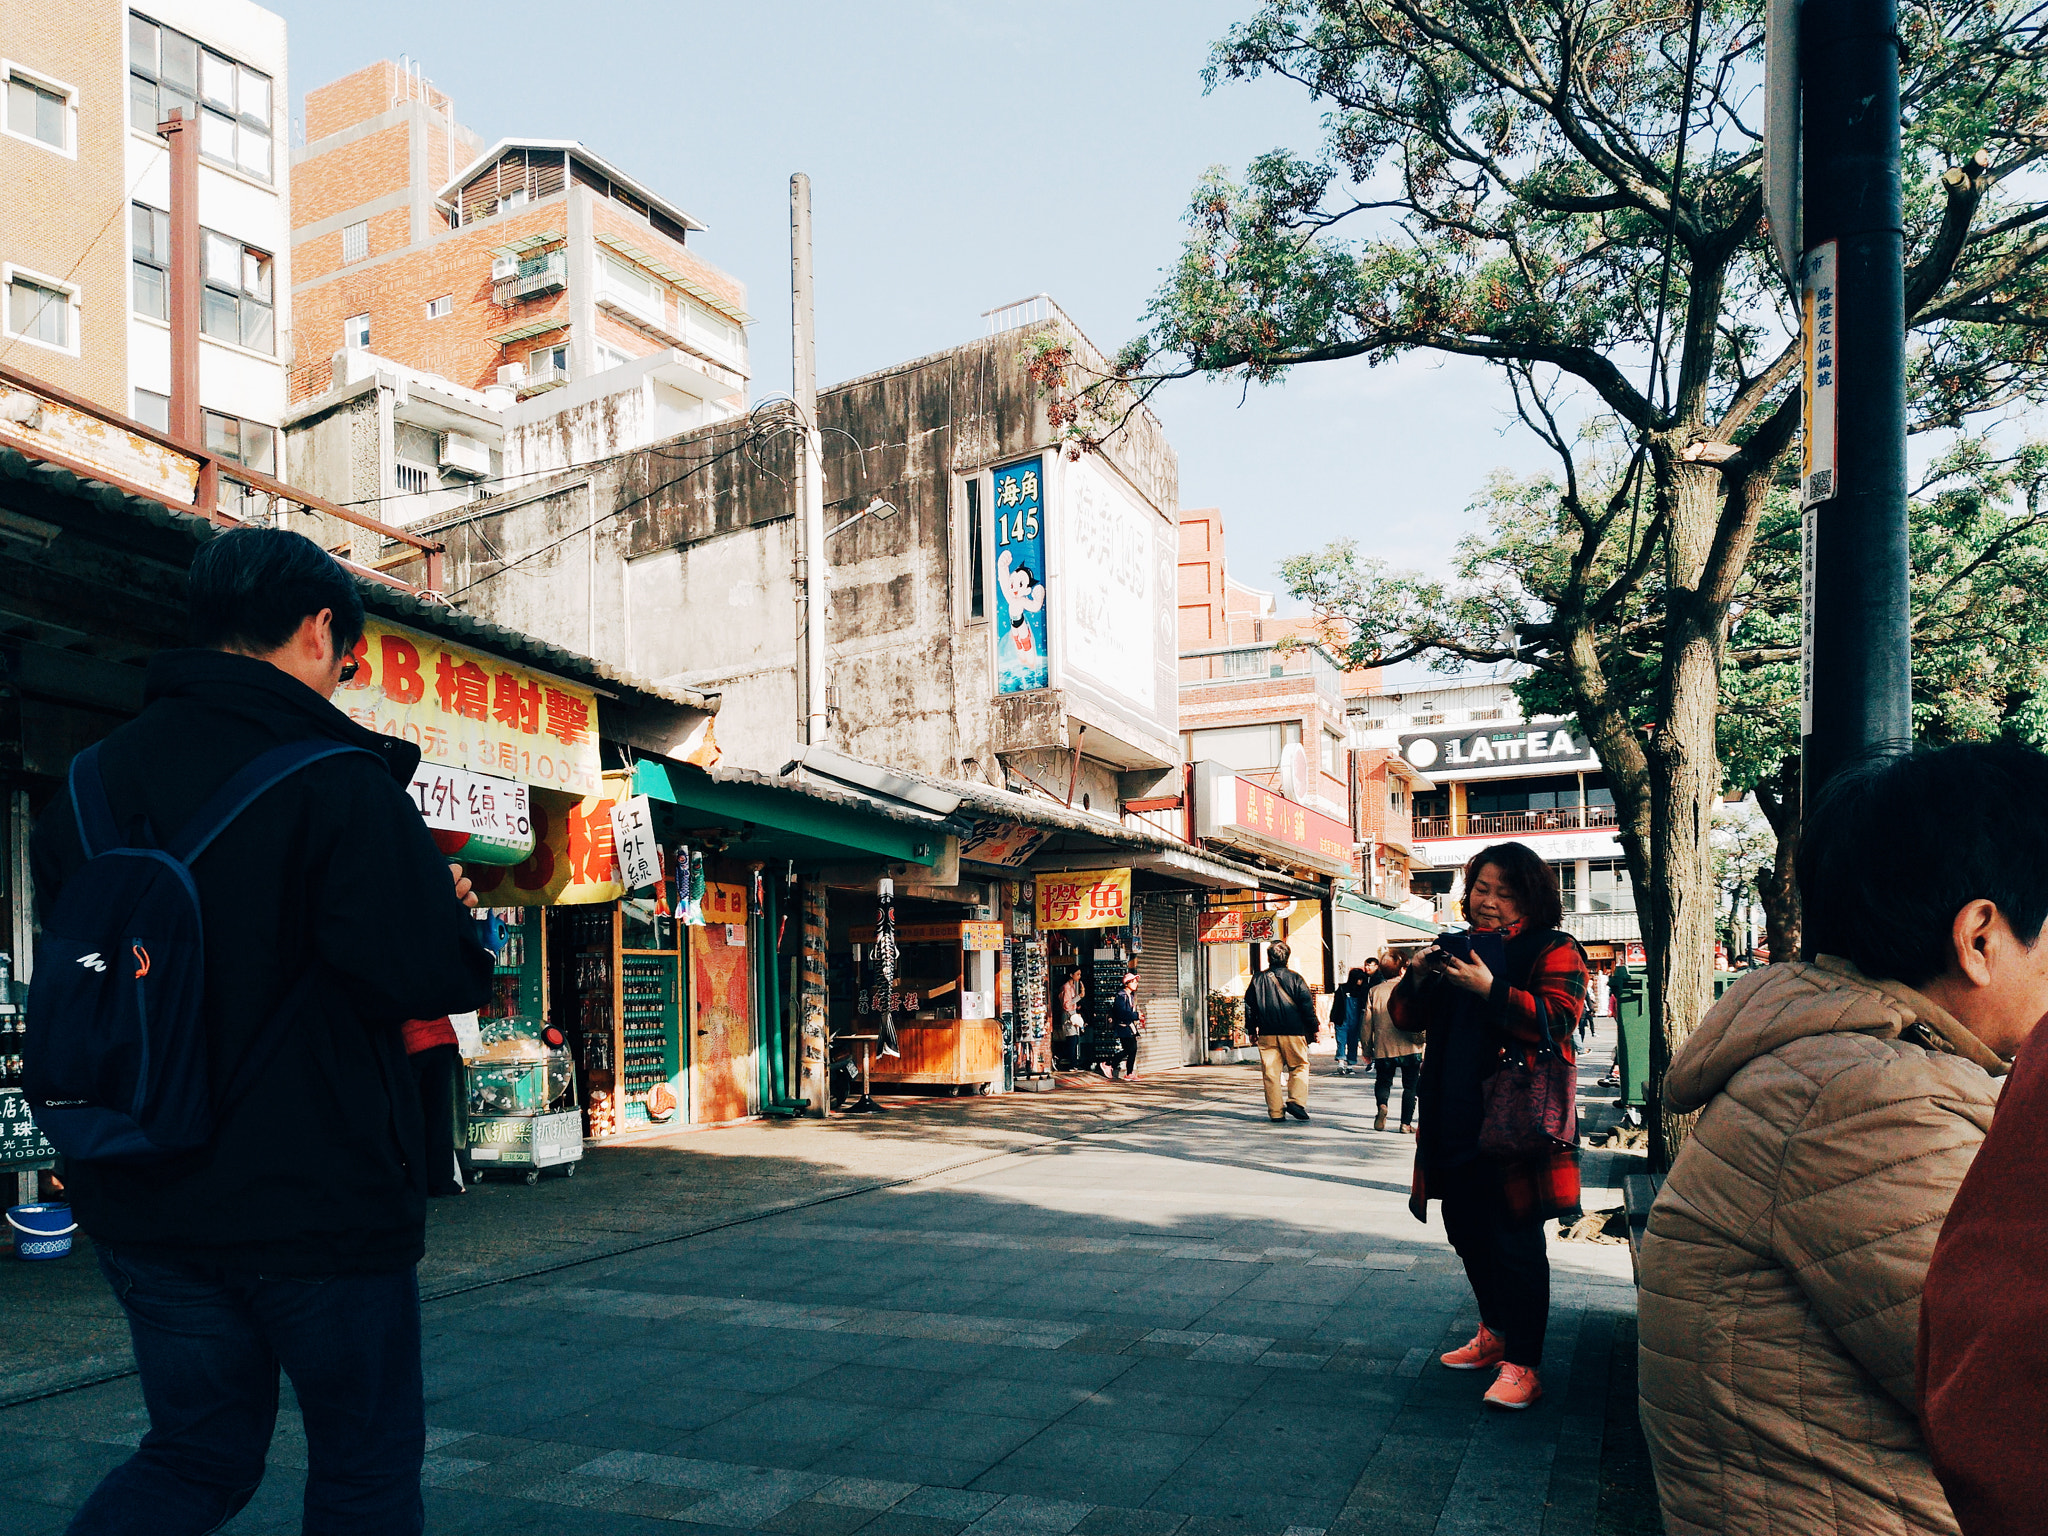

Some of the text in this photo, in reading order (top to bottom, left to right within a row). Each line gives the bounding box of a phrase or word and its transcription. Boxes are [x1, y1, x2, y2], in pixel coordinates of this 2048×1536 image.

[1817, 287, 1833, 388] 路燈定位編號
[996, 470, 1039, 508] 海角
[999, 507, 1040, 546] 145
[506, 813, 529, 836] 50
[617, 809, 652, 887] 紅外線
[1041, 882, 1127, 922] 撈魚
[0, 1096, 32, 1119] 店有
[468, 1121, 531, 1144] 抓抓樂
